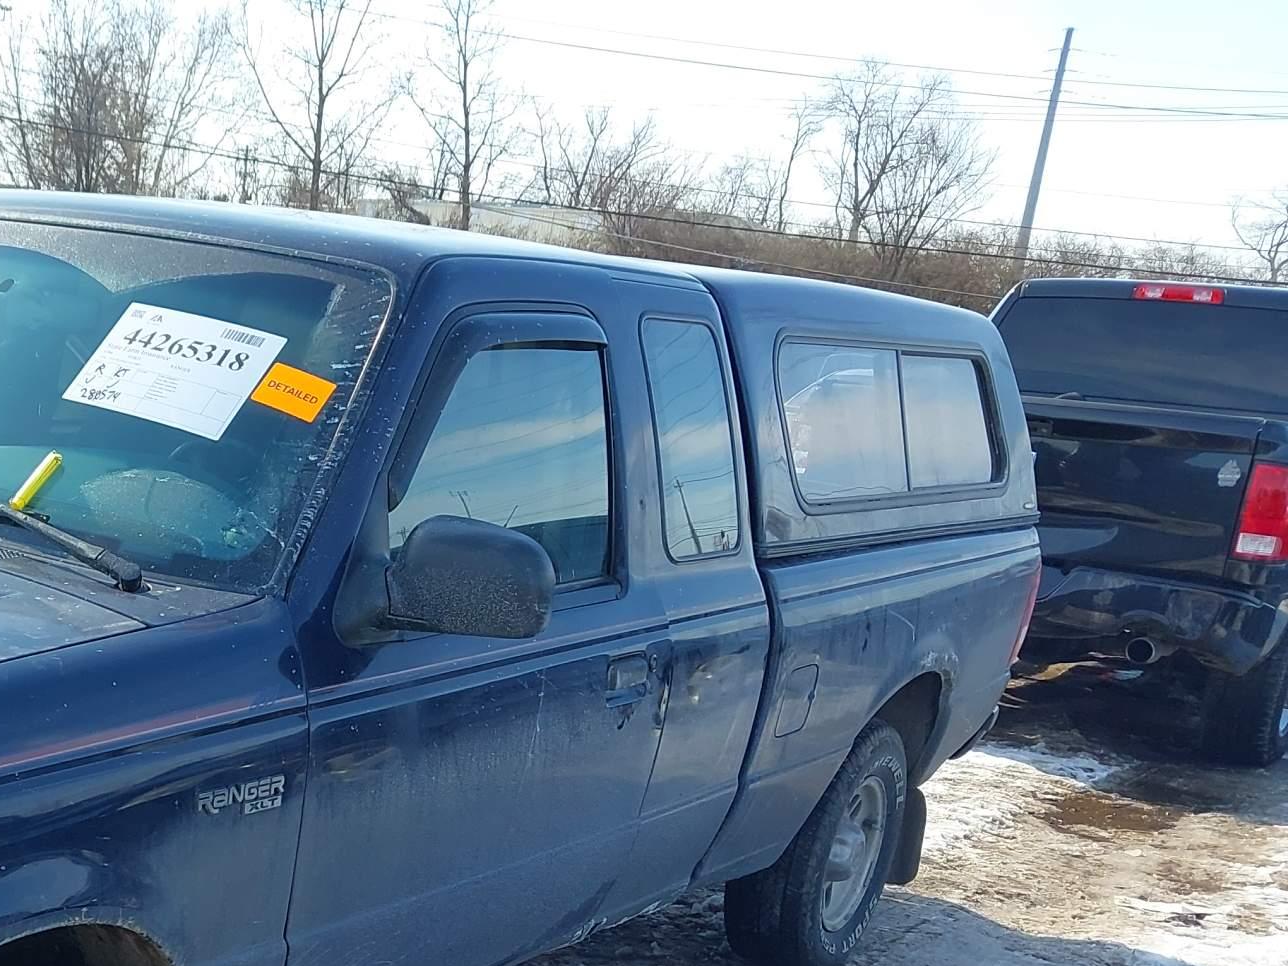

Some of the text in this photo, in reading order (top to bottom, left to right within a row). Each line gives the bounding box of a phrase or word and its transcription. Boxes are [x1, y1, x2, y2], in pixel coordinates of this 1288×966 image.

[123, 328, 250, 372] 44265318
[267, 379, 319, 404] DETAILED
[198, 775, 285, 814] RANGER
[247, 797, 281, 814] XLT
